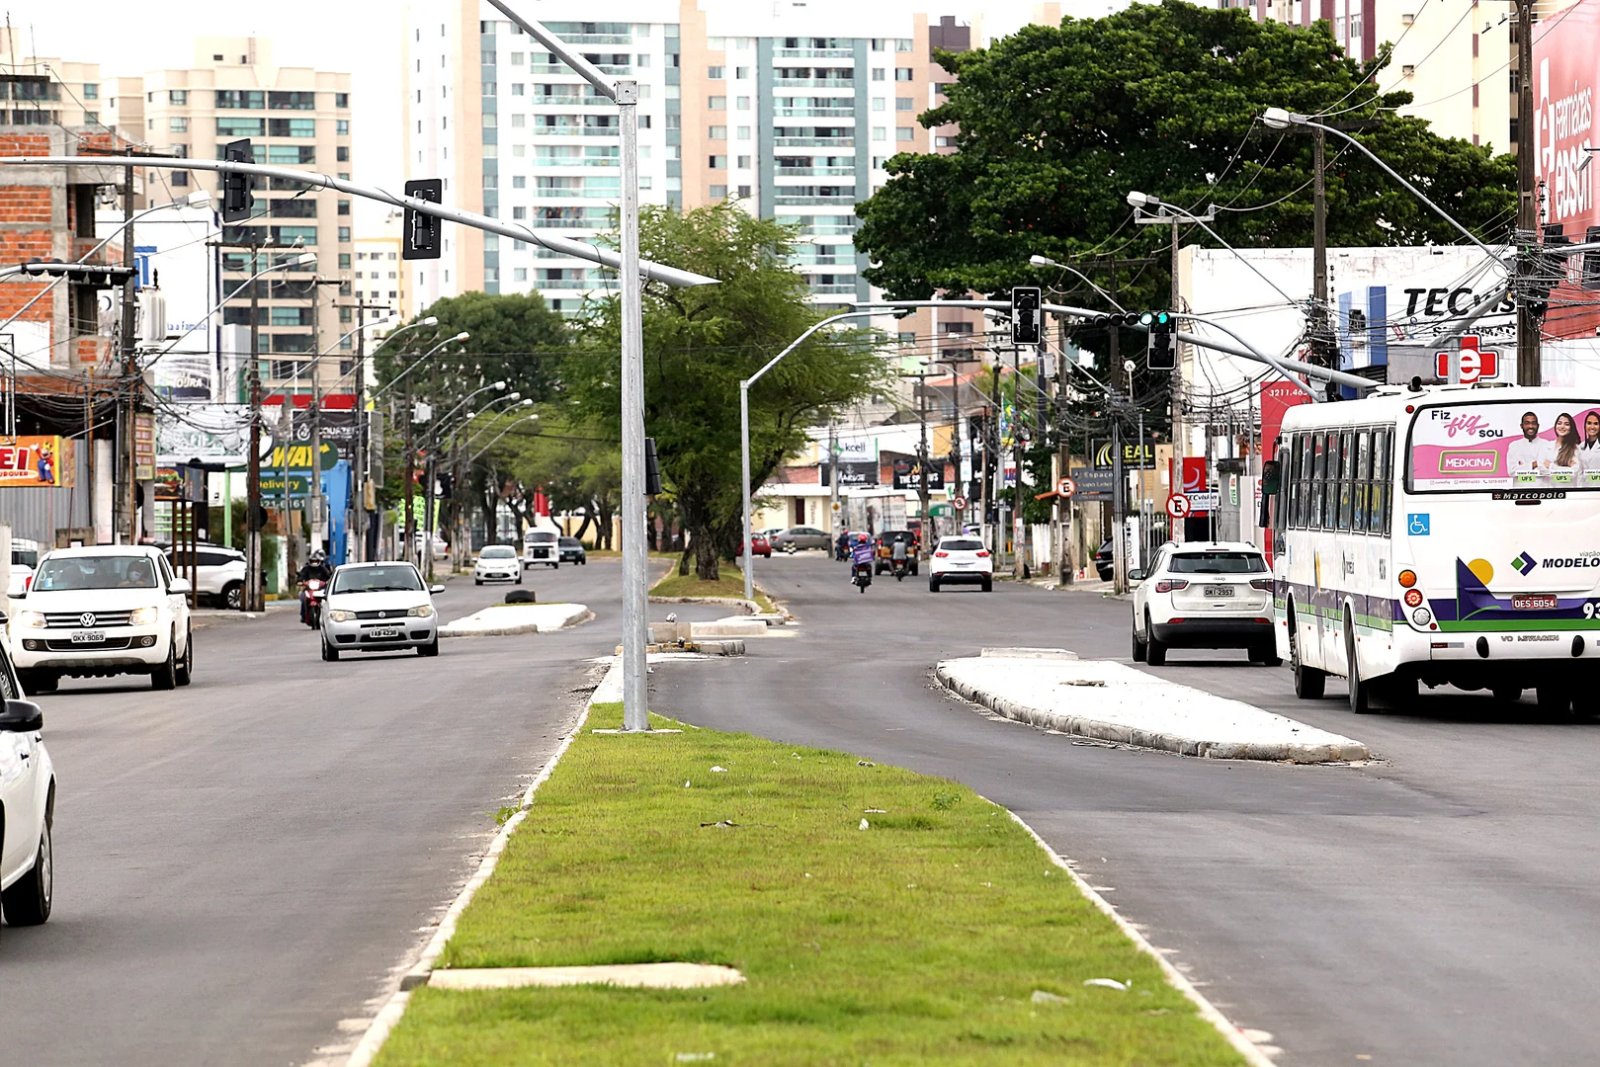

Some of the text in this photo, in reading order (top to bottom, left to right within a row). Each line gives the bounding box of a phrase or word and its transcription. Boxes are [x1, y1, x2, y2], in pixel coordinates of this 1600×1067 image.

[1431, 410, 1451, 420] Fiz
[1478, 429, 1504, 438] sou
[1445, 458, 1492, 468] MEDICINA
[1503, 492, 1565, 500] Marcopolo
[1542, 557, 1600, 569] MODELO
